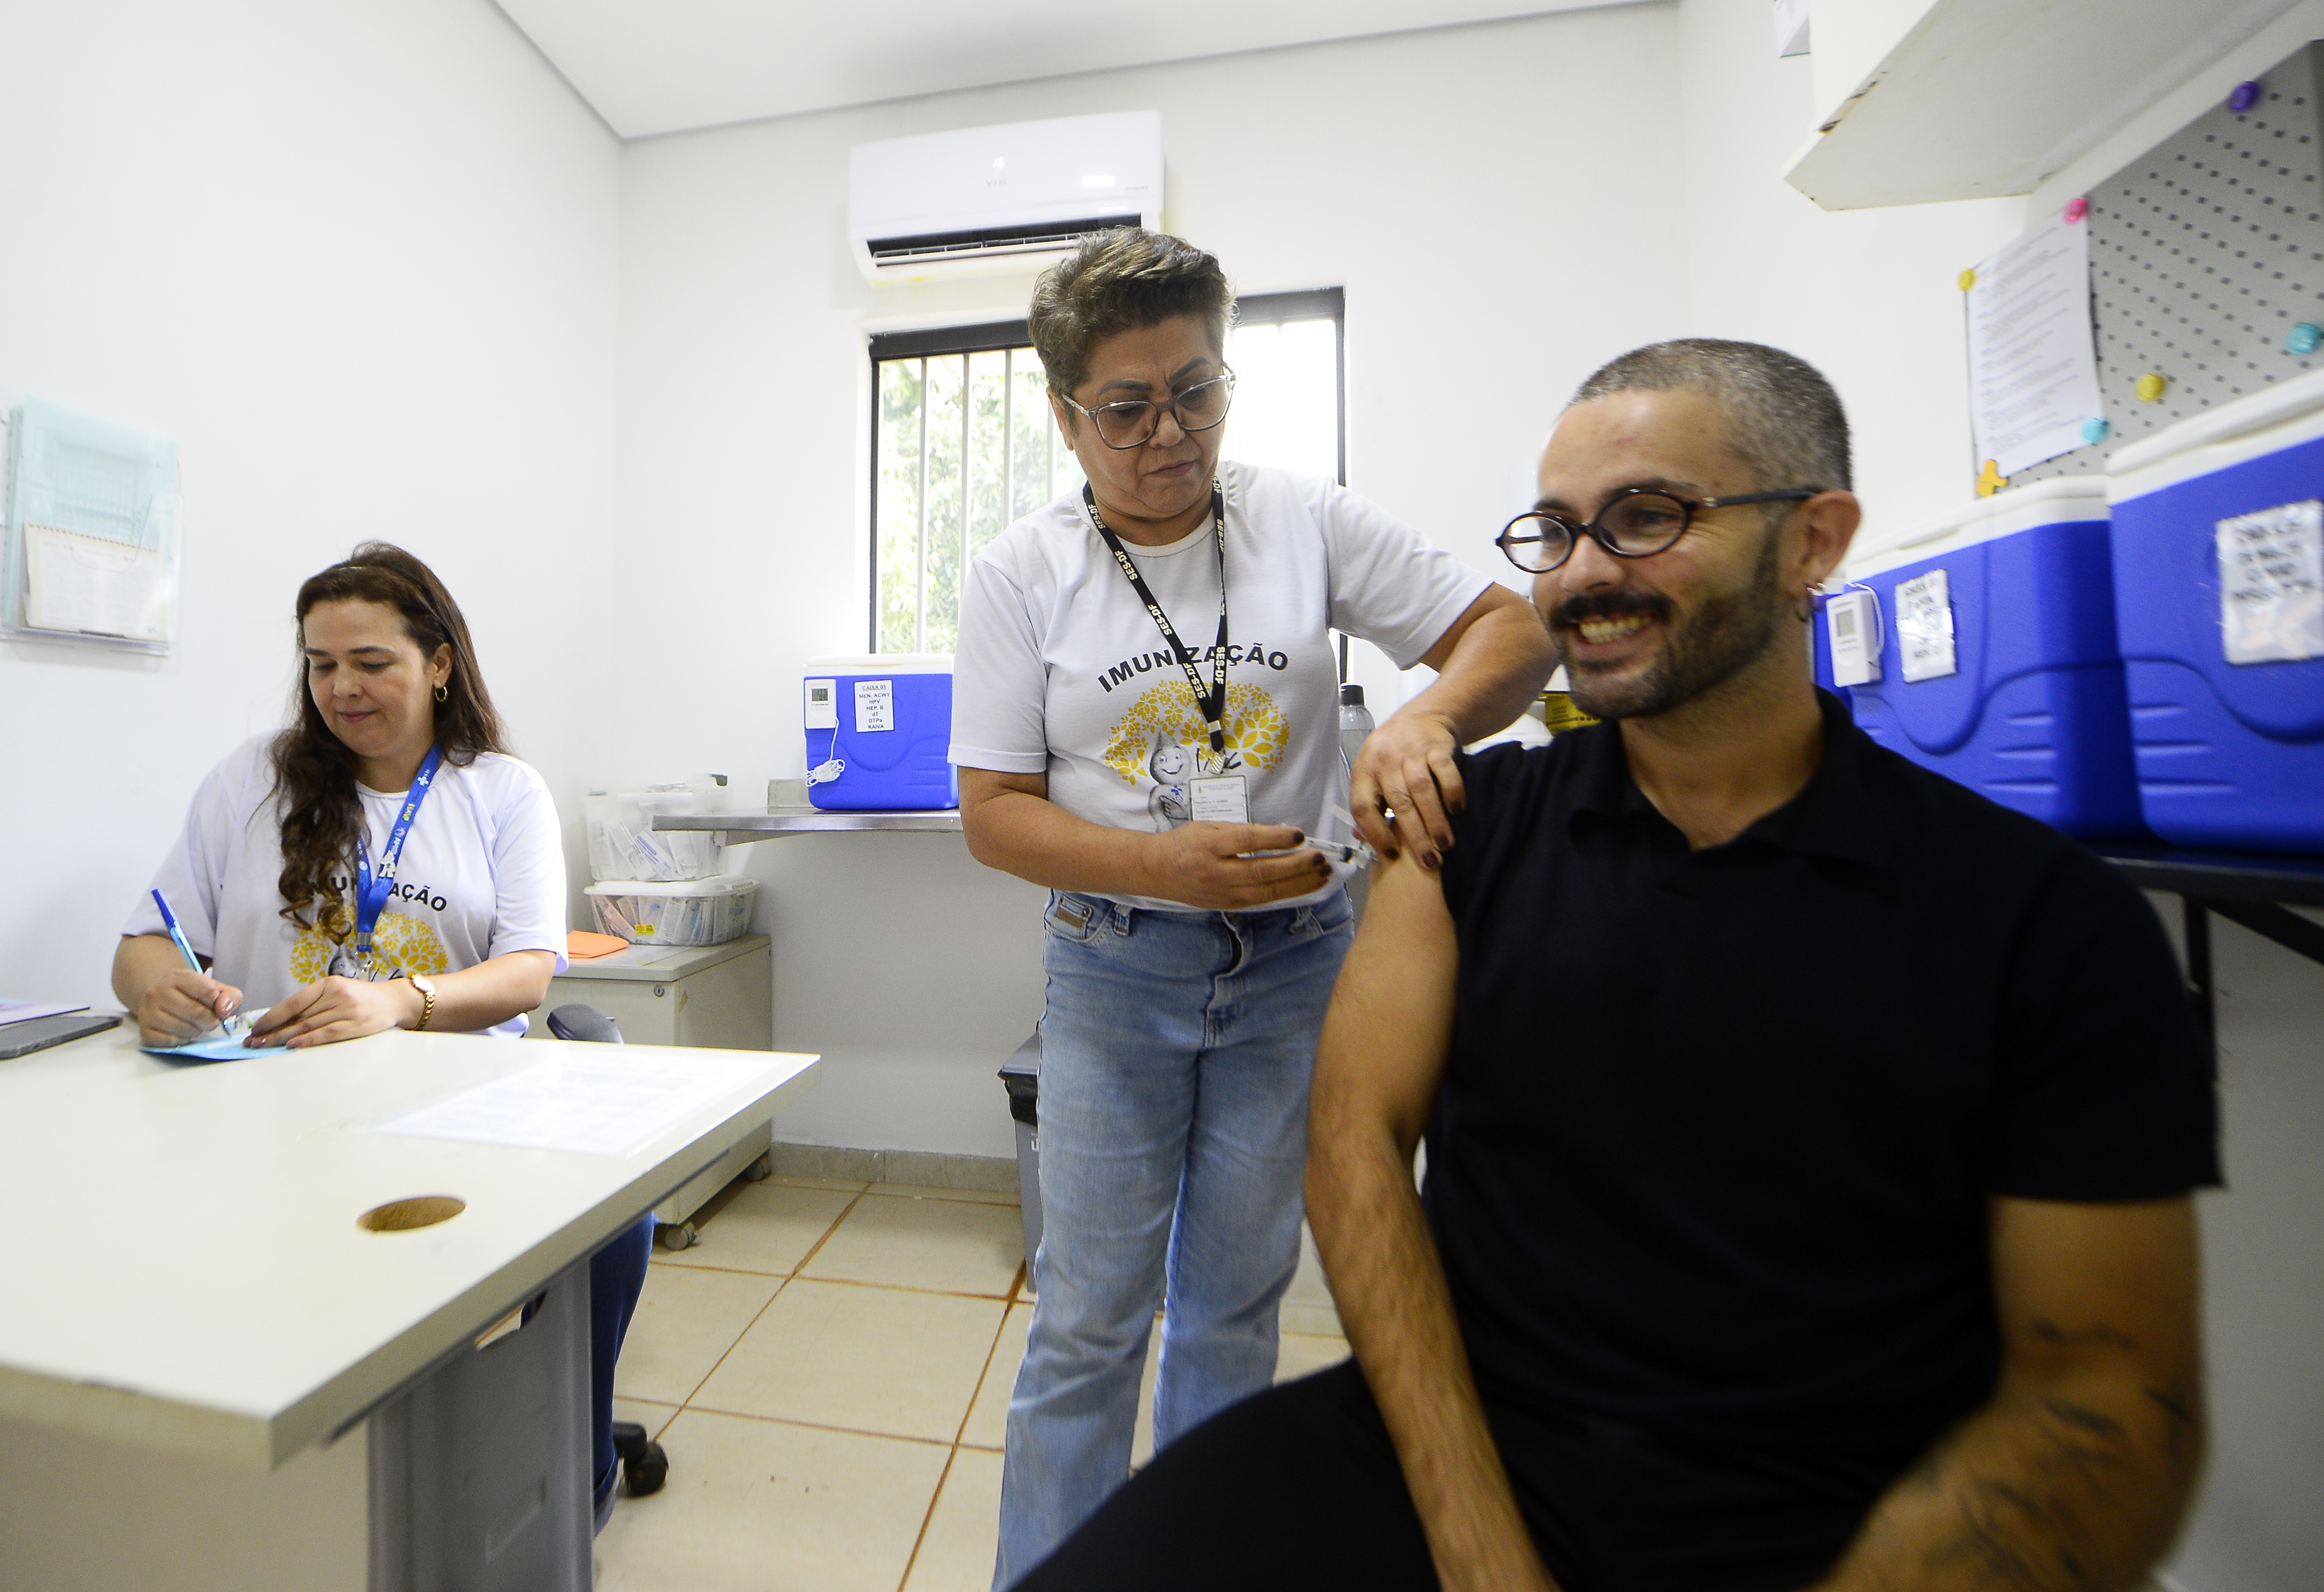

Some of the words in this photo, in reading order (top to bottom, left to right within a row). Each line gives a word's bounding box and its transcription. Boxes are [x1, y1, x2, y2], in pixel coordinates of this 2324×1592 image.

[1114, 550, 1138, 580] SES-DF
[1148, 604, 1173, 636] SES-DF
[1183, 663, 1206, 699] SES-DF
[1215, 646, 1225, 685] SES-DF
